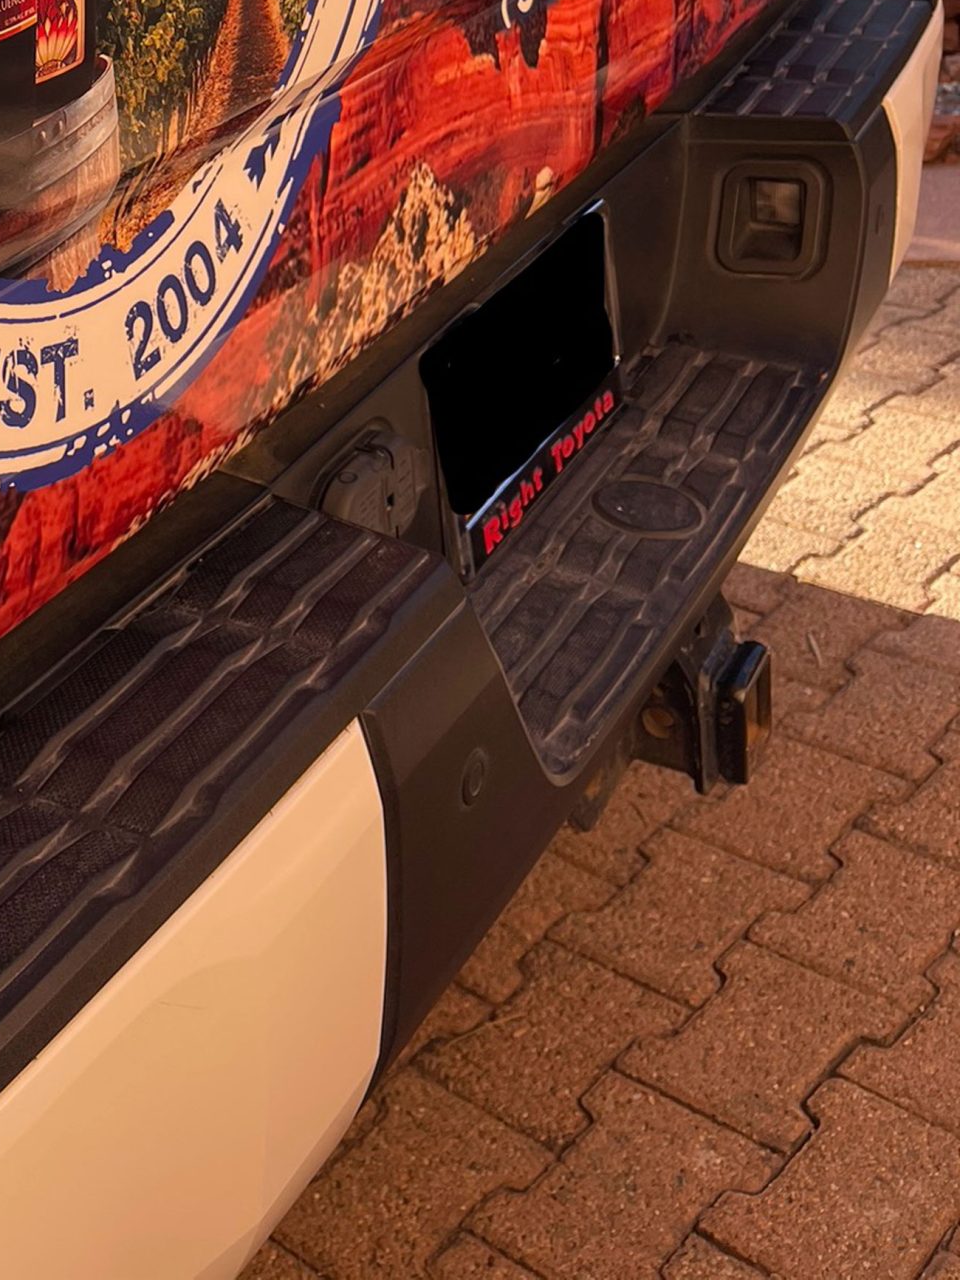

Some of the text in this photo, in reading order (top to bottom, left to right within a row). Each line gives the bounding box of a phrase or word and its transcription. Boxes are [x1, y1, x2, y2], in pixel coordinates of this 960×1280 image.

[125, 198, 244, 381] 2004
[481, 390, 615, 555] Right Toyota
